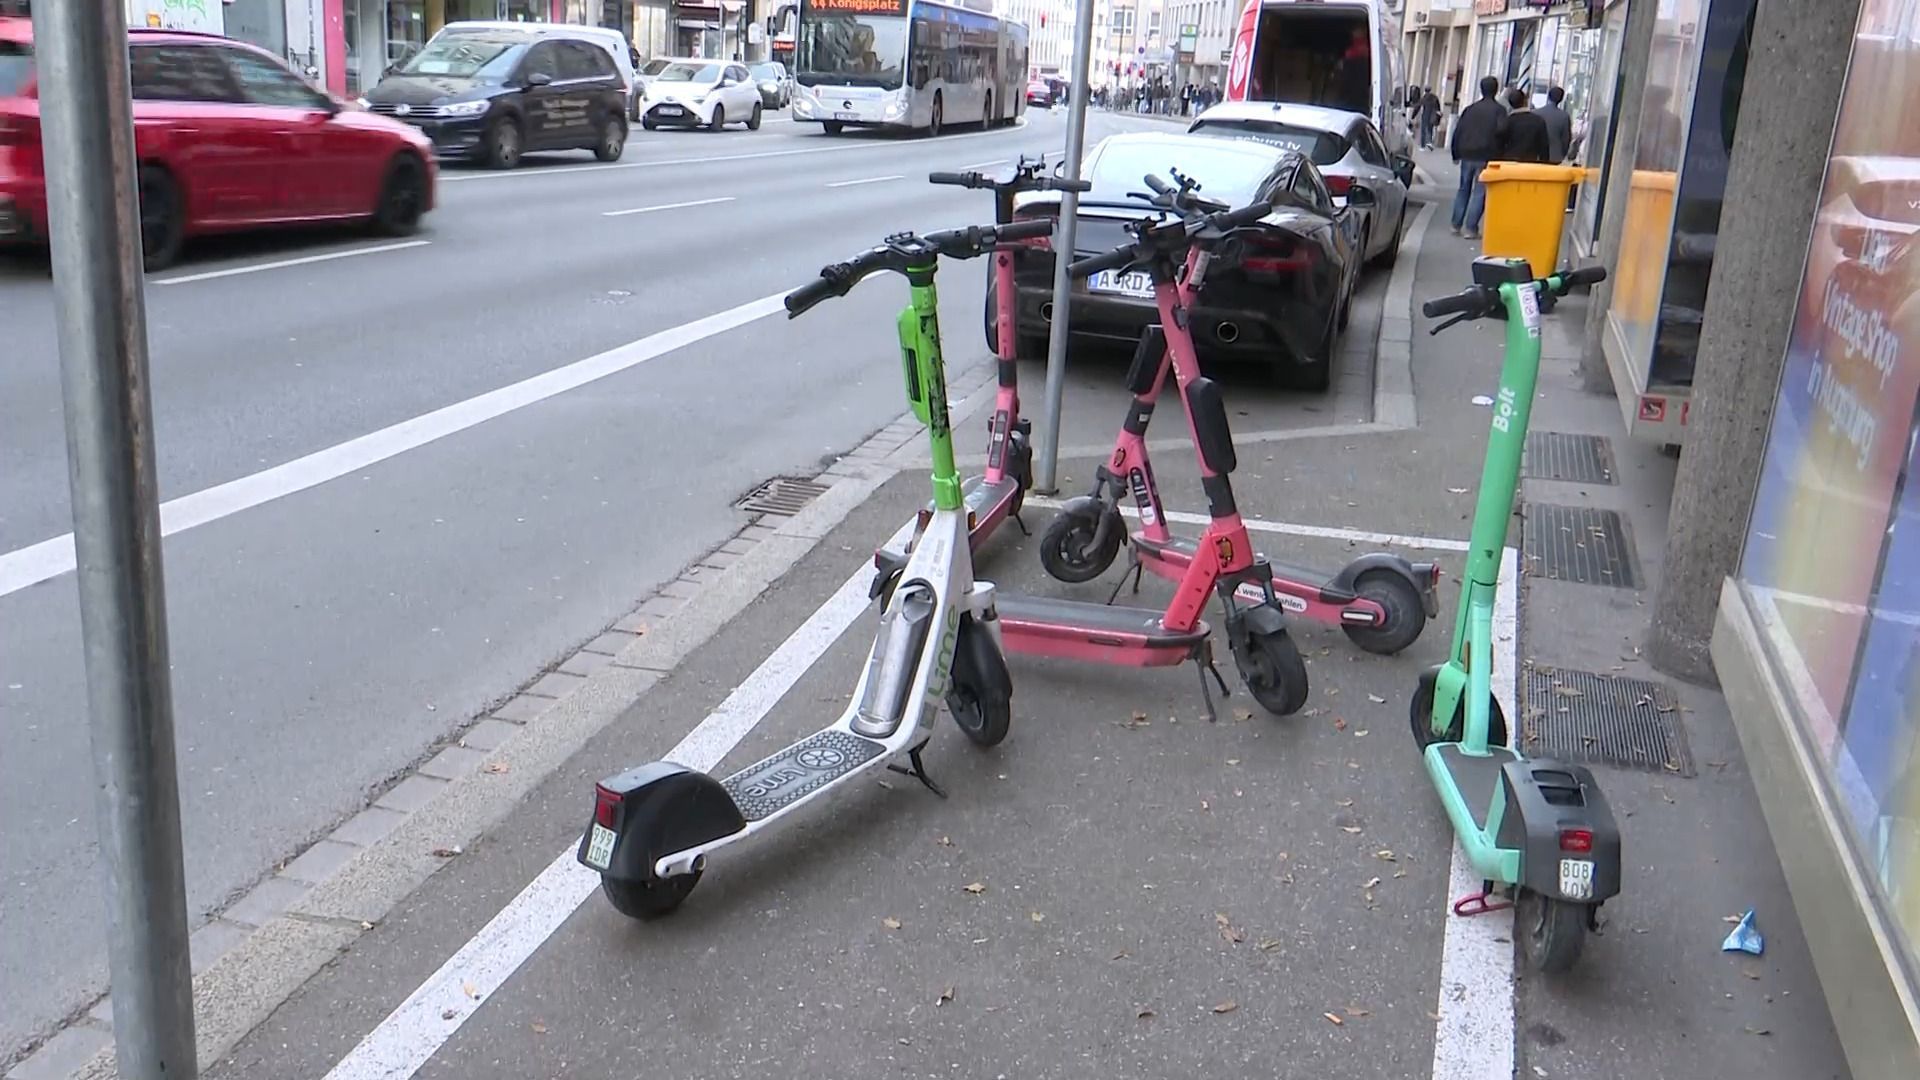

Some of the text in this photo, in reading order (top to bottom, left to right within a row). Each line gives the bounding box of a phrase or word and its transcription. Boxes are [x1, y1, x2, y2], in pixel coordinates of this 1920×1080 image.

[1099, 270, 1109, 288] A
[1121, 273, 1144, 291] RD
[1823, 278, 1899, 391] Vintage Shop
[1492, 387, 1517, 433] Bolt
[1807, 348, 1876, 472] in Augsburg
[1277, 596, 1304, 610] ahlen.
[927, 603, 959, 697] Lime
[744, 767, 807, 798] Lime
[592, 827, 614, 848] 999
[1562, 862, 1590, 880] 808
